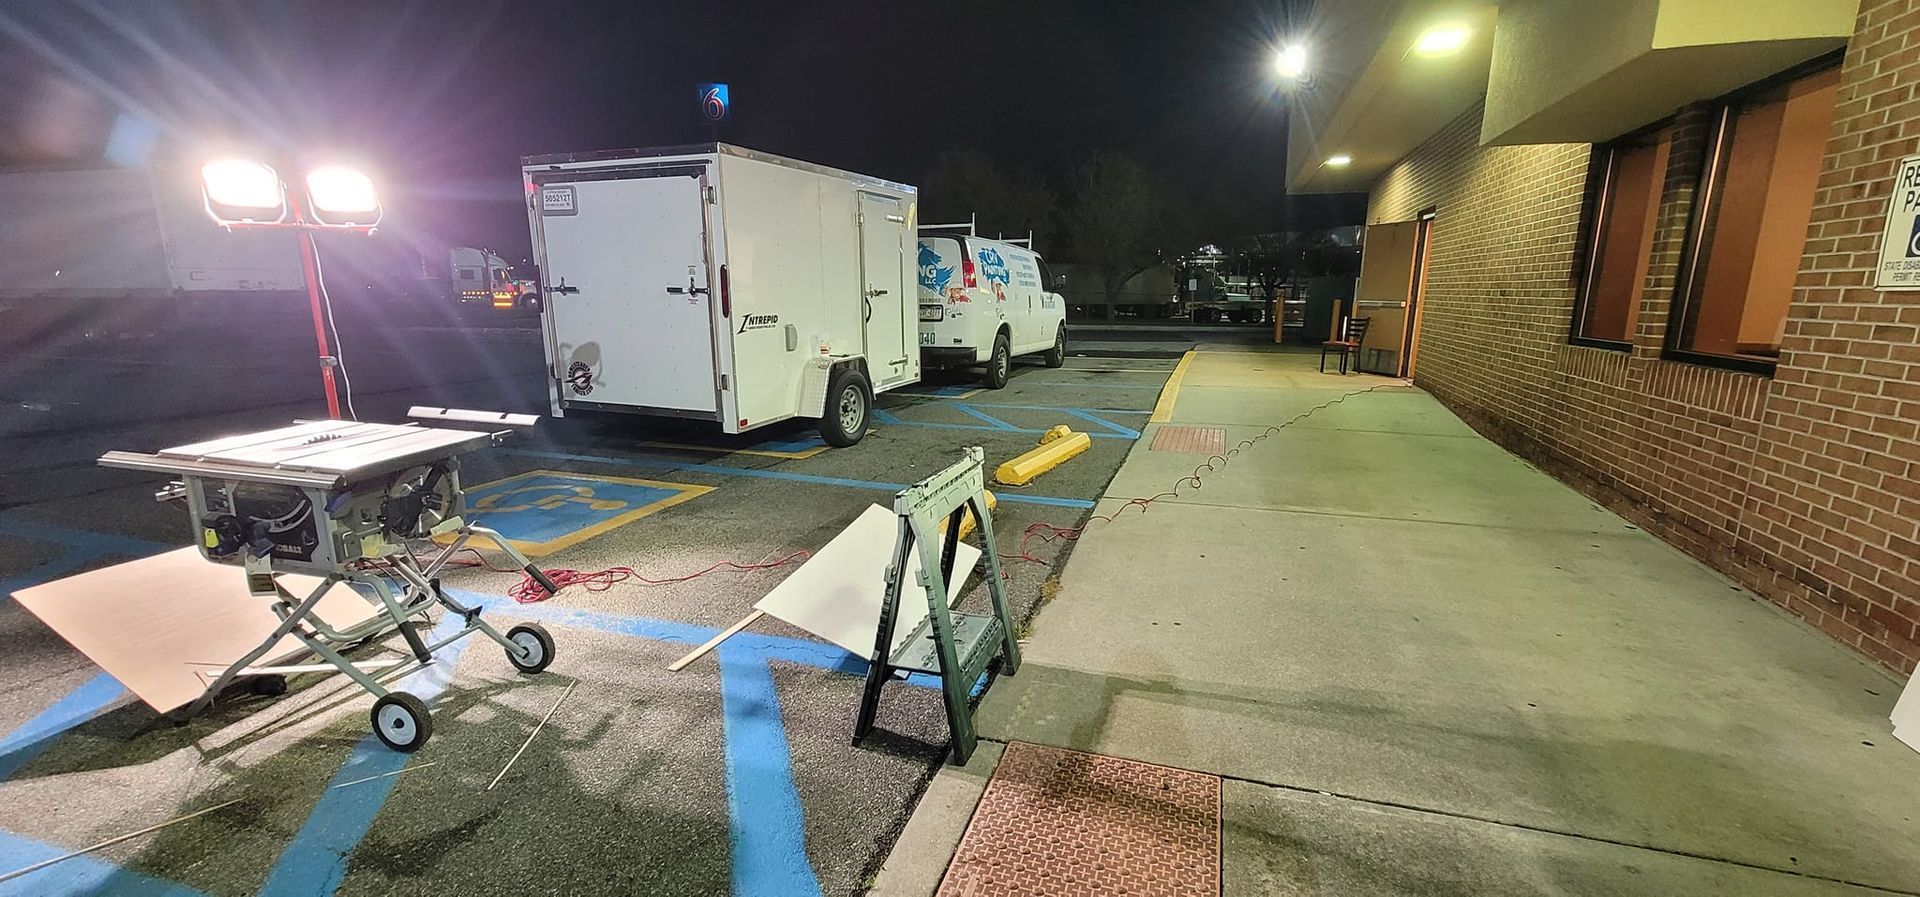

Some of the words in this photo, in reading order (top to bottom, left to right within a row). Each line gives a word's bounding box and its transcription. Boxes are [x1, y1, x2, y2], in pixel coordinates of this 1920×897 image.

[703, 87, 725, 121] 6
[1884, 261, 1903, 271] STATE
[736, 313, 779, 335] INTREPID
